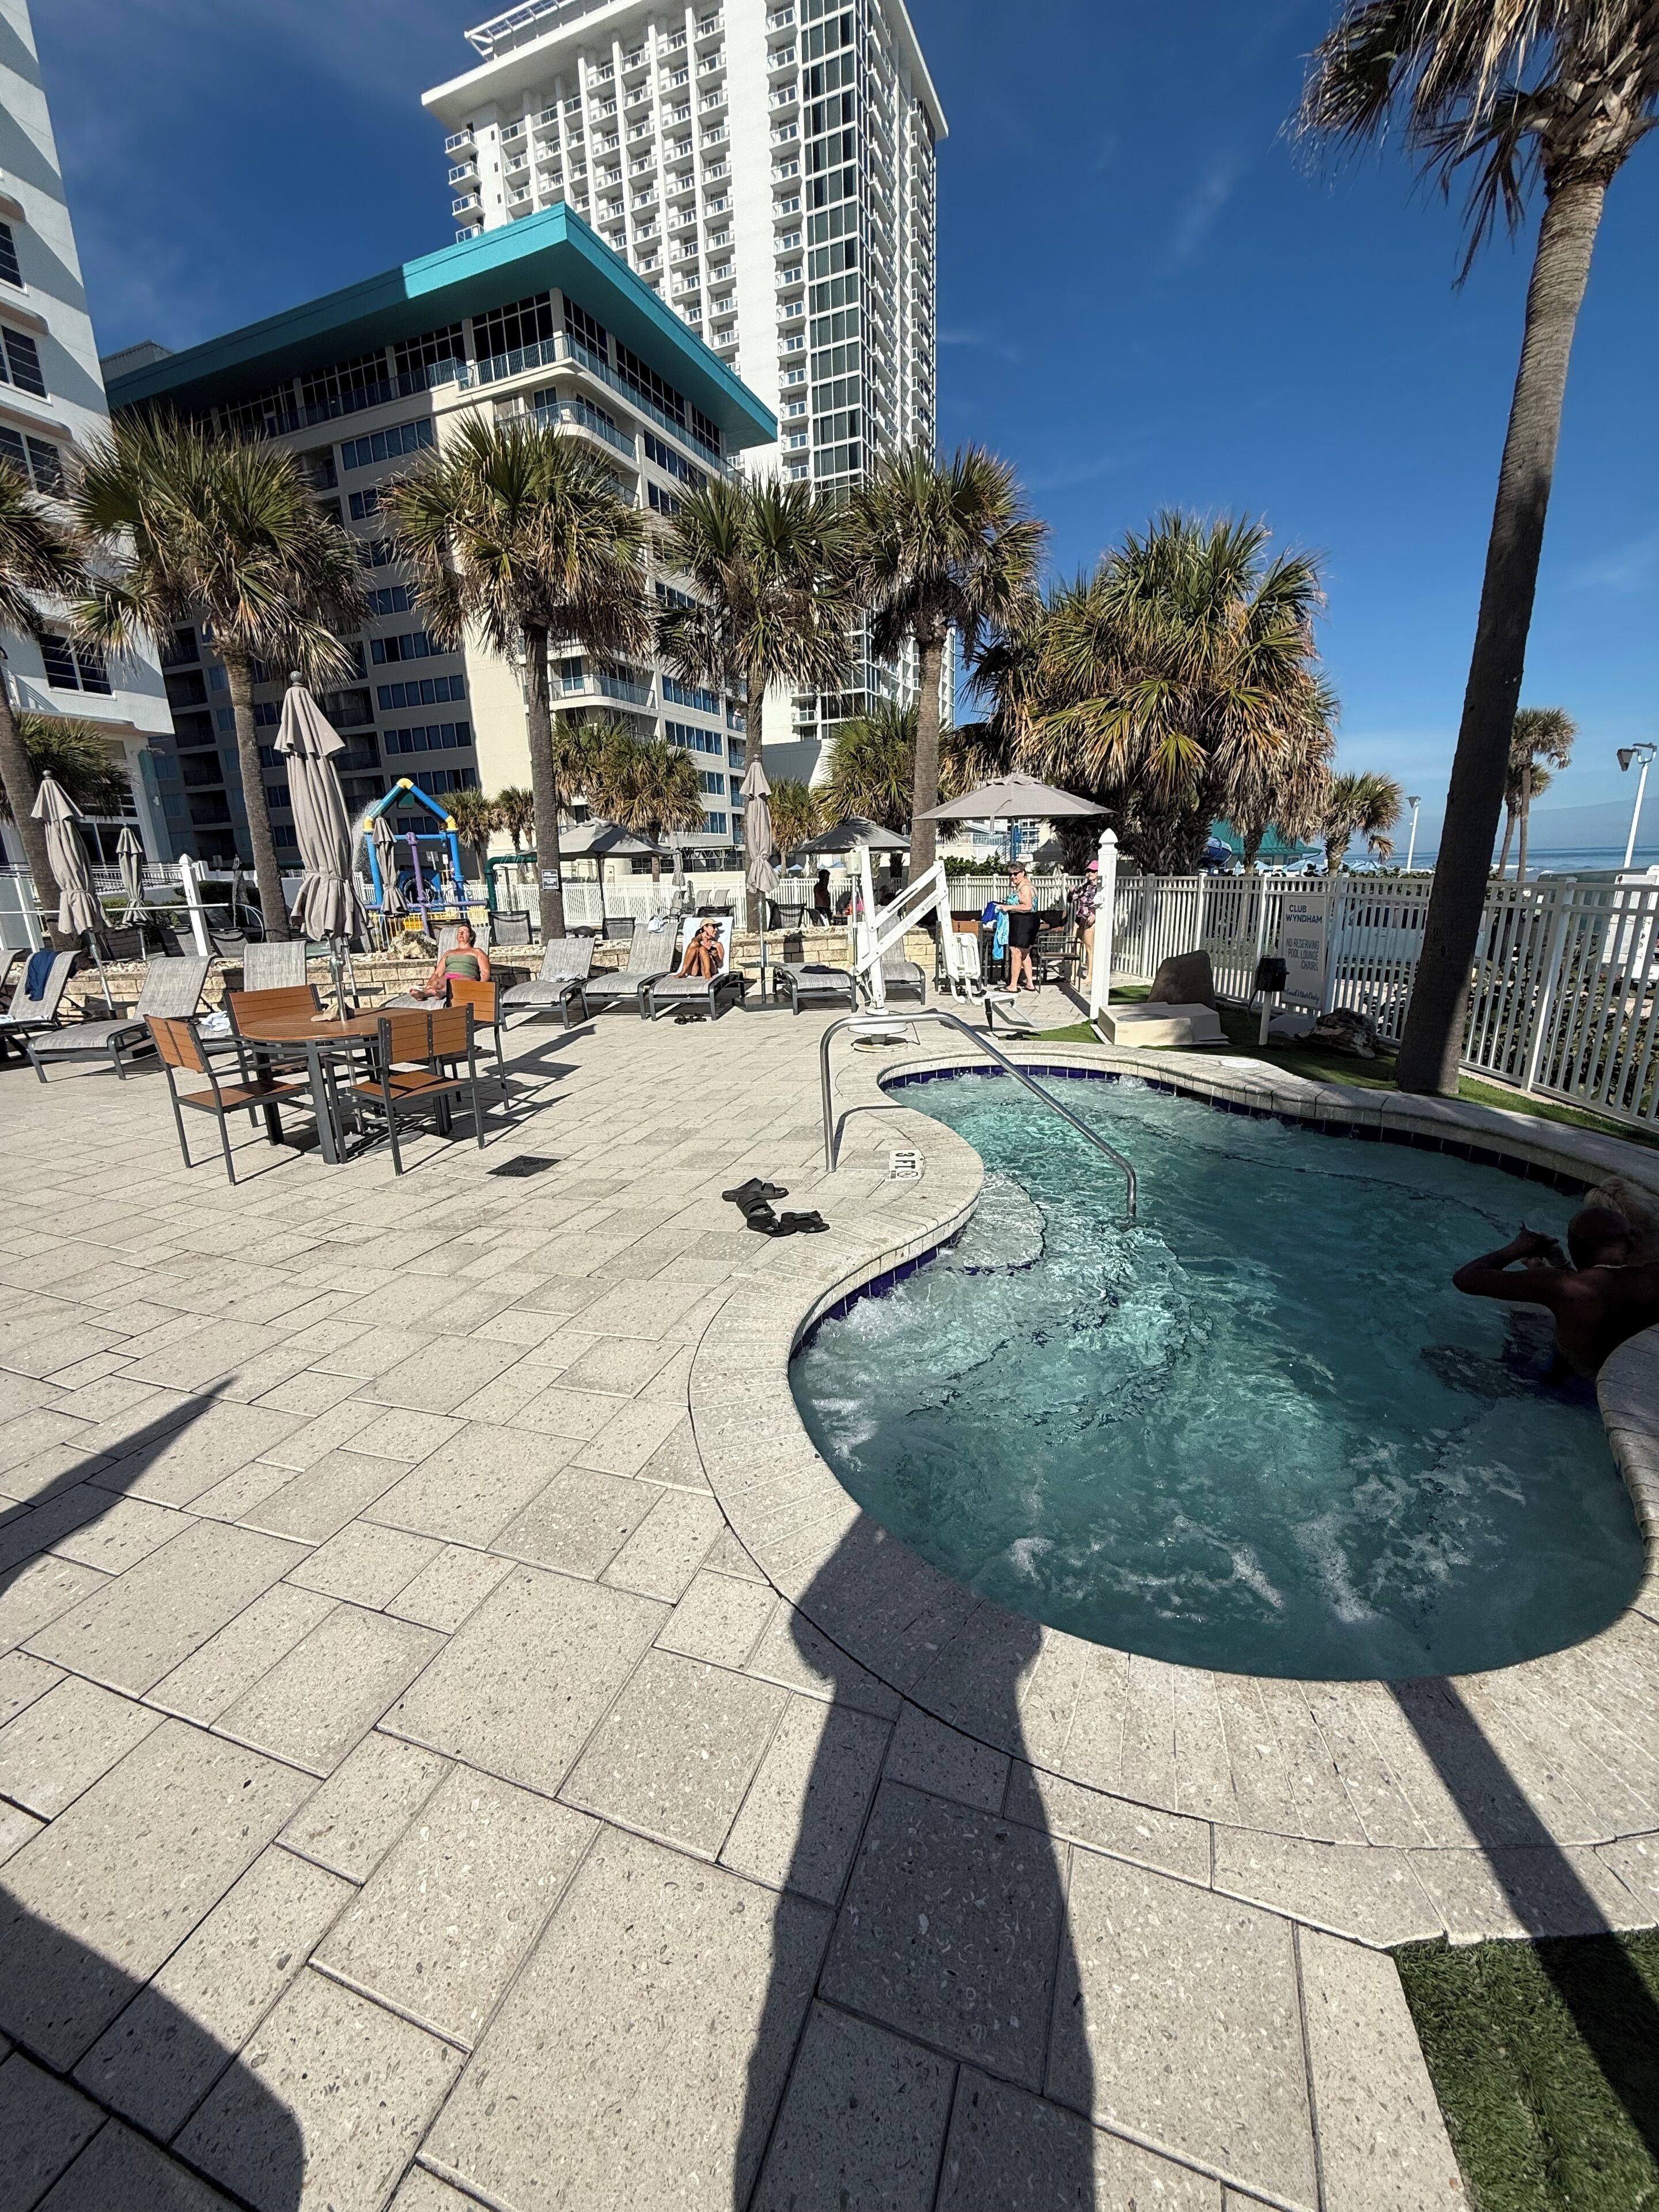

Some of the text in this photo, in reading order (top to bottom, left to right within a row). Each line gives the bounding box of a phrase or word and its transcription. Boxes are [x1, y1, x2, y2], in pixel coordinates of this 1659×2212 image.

[1289, 904, 1306, 912] CLUB
[1286, 914, 1322, 923] WYNDHAM
[1286, 938, 1319, 950] NO RESERVING
[1288, 948, 1319, 960] POOL LOUNGE
[1301, 960, 1319, 971] CHAIRS
[895, 1160, 915, 1169] FT
